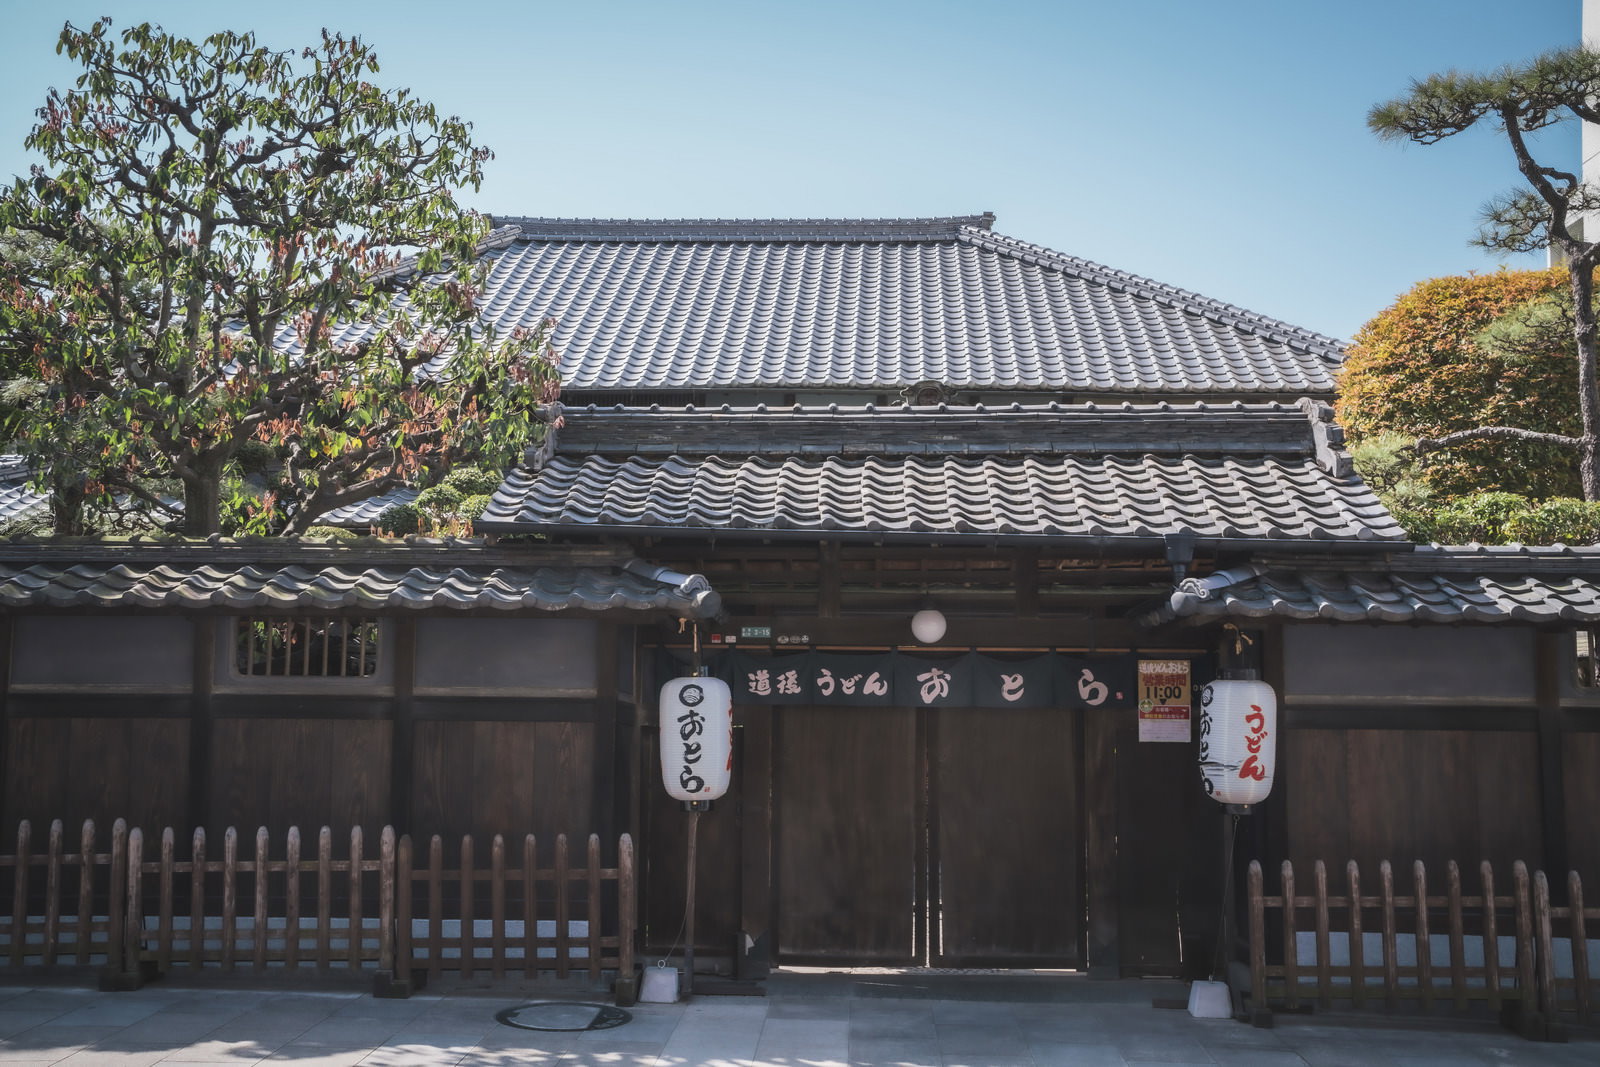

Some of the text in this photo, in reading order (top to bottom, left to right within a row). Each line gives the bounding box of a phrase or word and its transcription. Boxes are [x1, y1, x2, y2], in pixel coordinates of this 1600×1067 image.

[748, 669, 802, 696] 道後
[816, 669, 888, 696] うどん
[1146, 686, 1182, 699] 11:00
[677, 709, 705, 793] おとら
[1239, 704, 1268, 781] うどん
